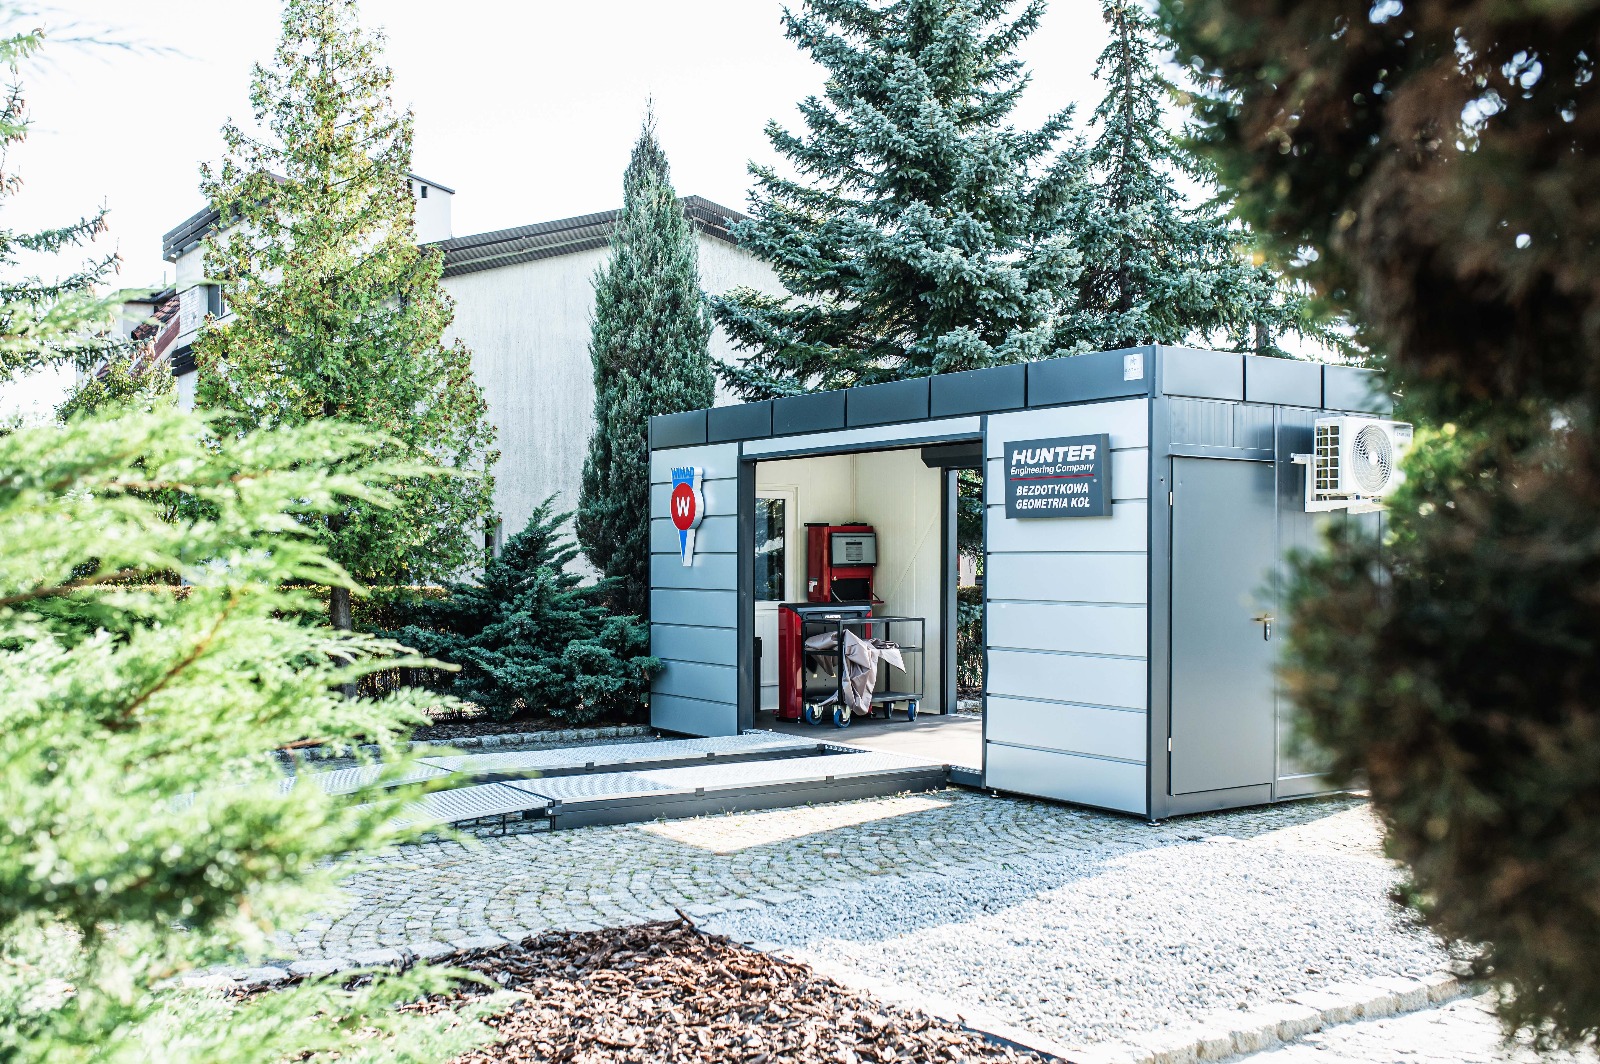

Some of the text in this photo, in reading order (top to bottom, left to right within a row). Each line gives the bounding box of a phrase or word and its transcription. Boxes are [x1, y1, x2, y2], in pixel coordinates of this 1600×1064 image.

[1011, 444, 1097, 465] HUNTER
[1010, 463, 1094, 476] Engineering Company
[1016, 482, 1089, 496] BEZDOTYKOWA
[676, 496, 690, 517] W
[1015, 496, 1091, 509] GEOMETRIA KOŁ
